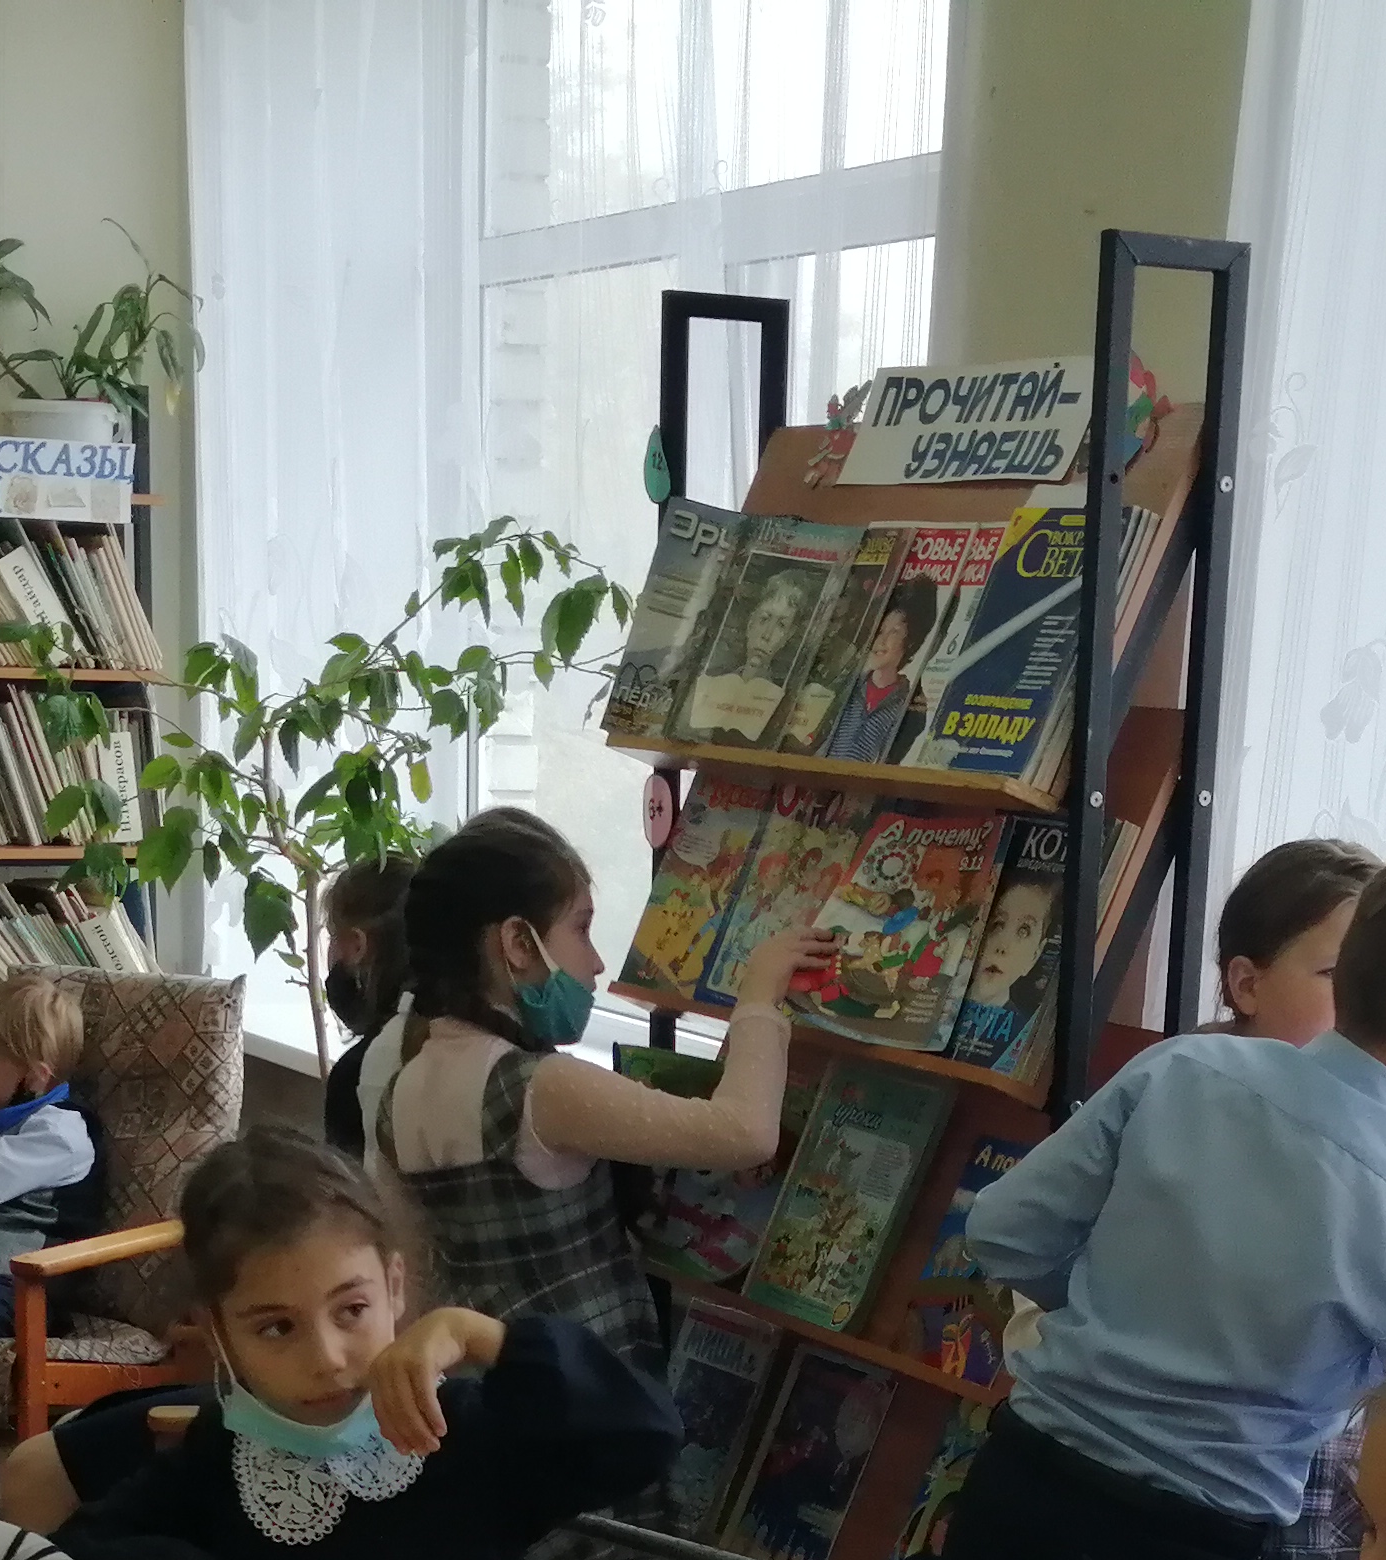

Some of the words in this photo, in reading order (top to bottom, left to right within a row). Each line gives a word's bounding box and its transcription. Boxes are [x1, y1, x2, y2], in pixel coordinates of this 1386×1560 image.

[871, 362, 1082, 427] ПРОЧИТАЙ-
[904, 428, 1065, 479] УЗНАЕШЬ
[13, 565, 55, 636] Гайдар
[943, 711, 960, 735] В
[959, 713, 1036, 745] ЭЛЛАДУ
[905, 820, 995, 851] почему?
[94, 923, 125, 972] олстой
